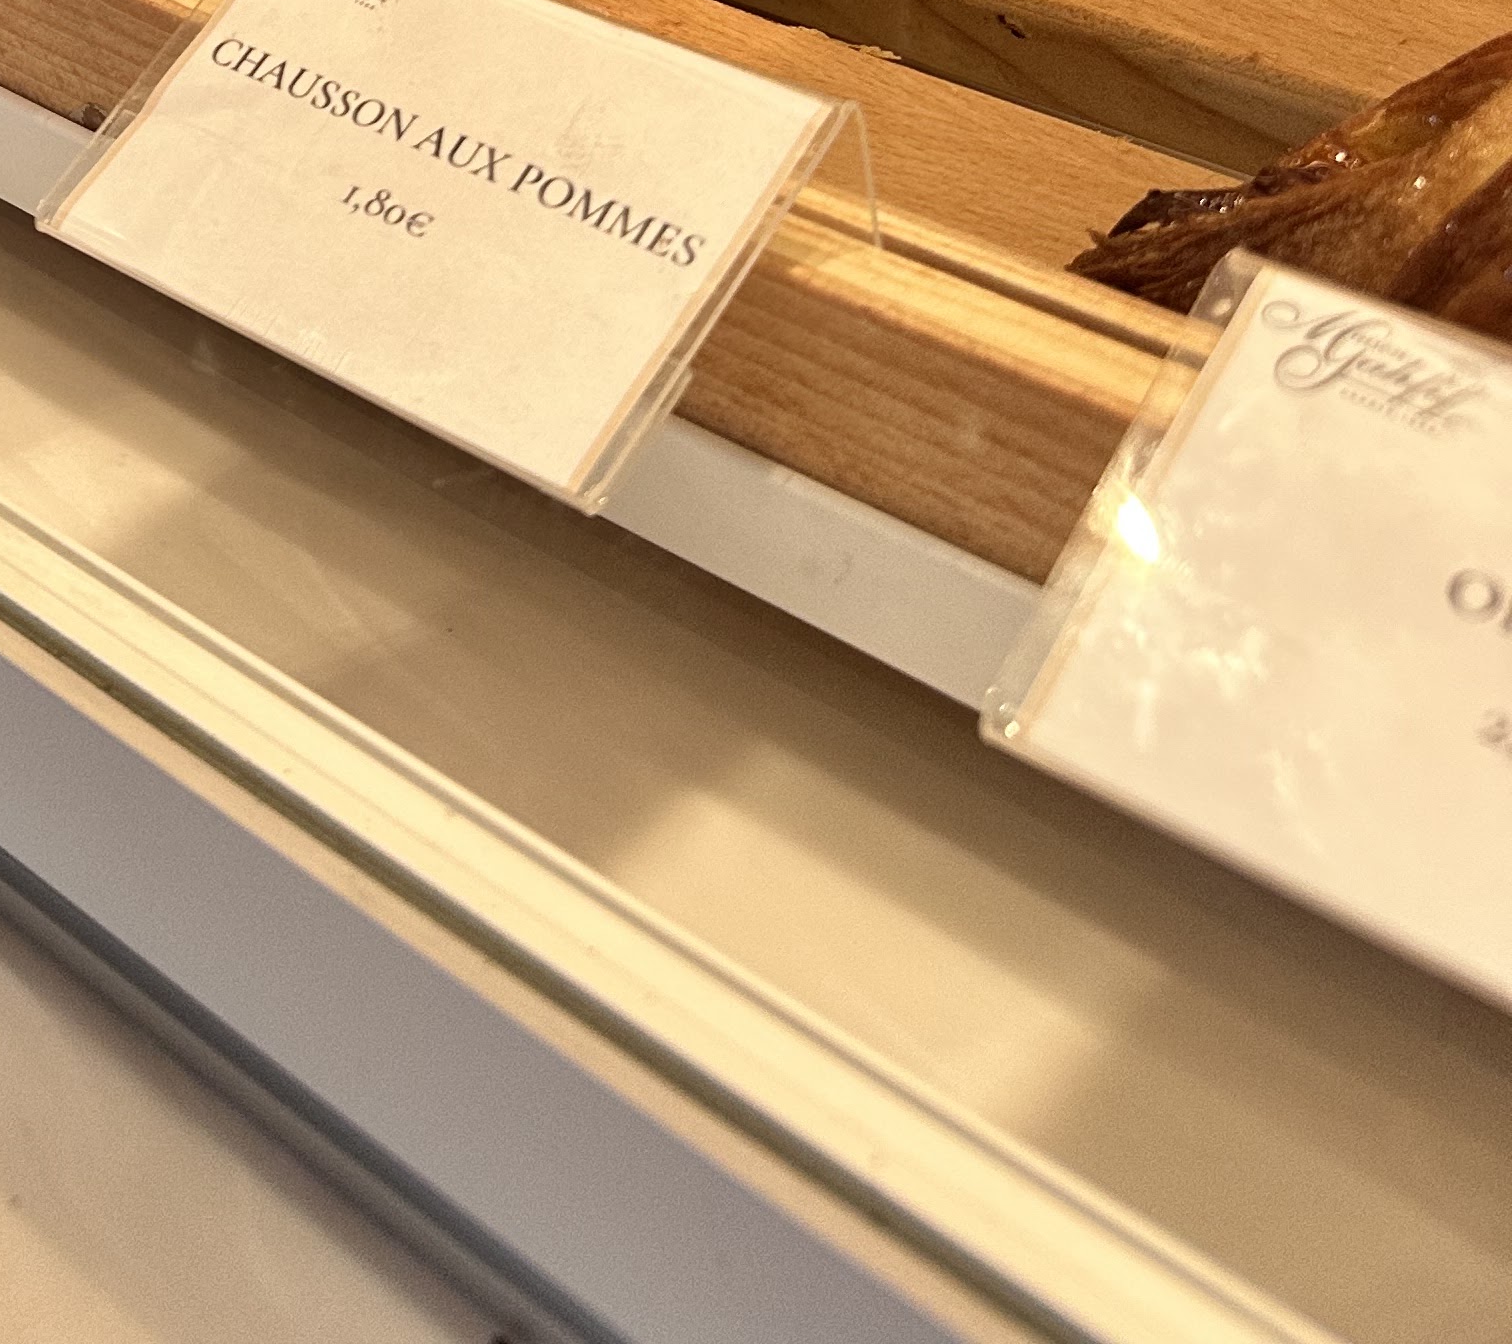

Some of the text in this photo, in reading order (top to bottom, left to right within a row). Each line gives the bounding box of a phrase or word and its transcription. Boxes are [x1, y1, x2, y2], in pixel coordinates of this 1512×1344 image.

[211, 37, 707, 267] CHAUSSON AUX POMMES
[340, 185, 436, 238] 1,80€
